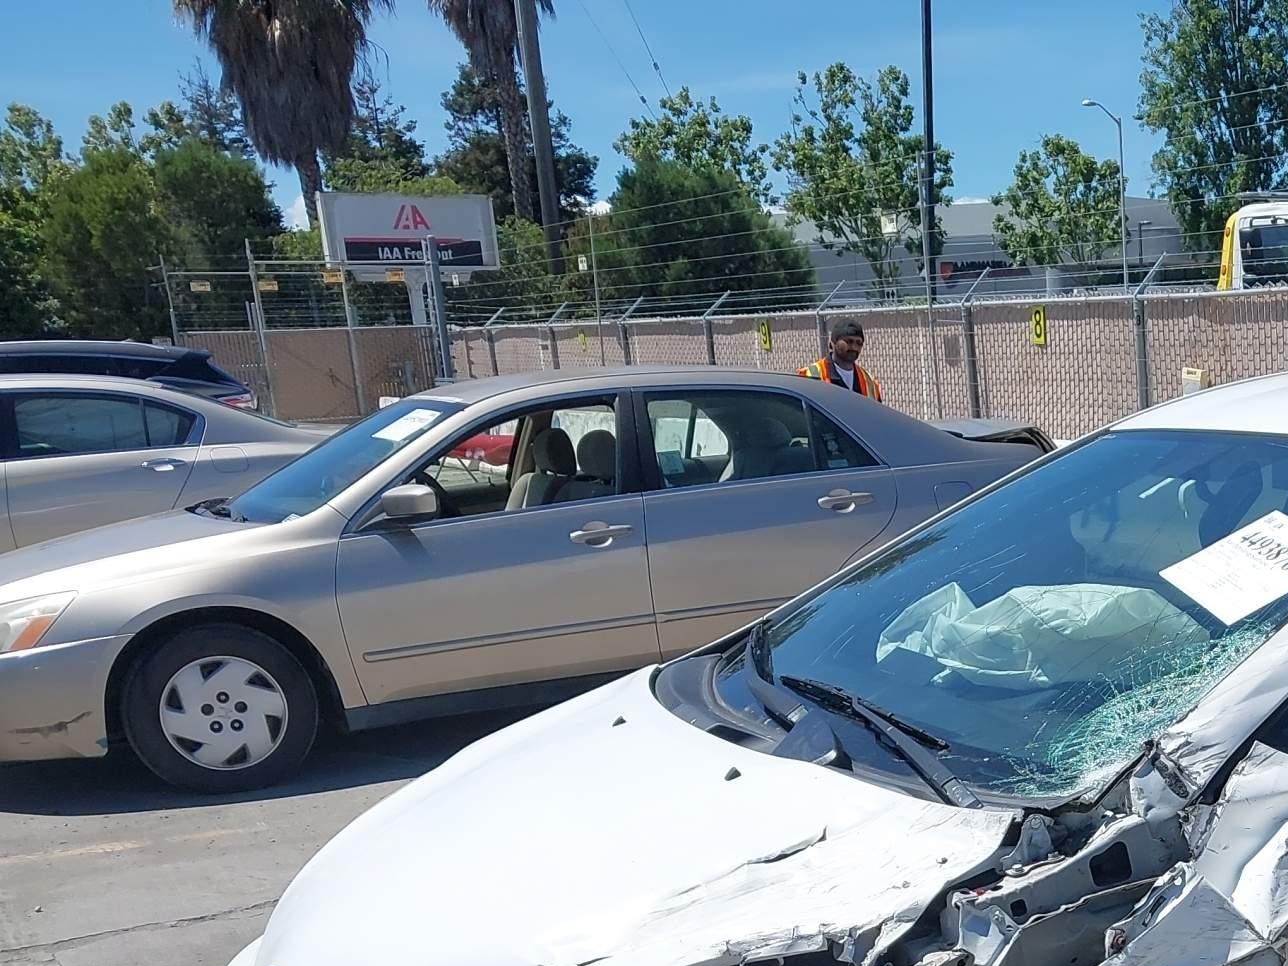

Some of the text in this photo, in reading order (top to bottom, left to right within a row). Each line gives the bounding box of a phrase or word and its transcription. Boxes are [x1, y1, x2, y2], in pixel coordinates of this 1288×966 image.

[378, 247, 401, 260] IAA
[760, 321, 768, 345] 9
[1034, 309, 1042, 339] 8
